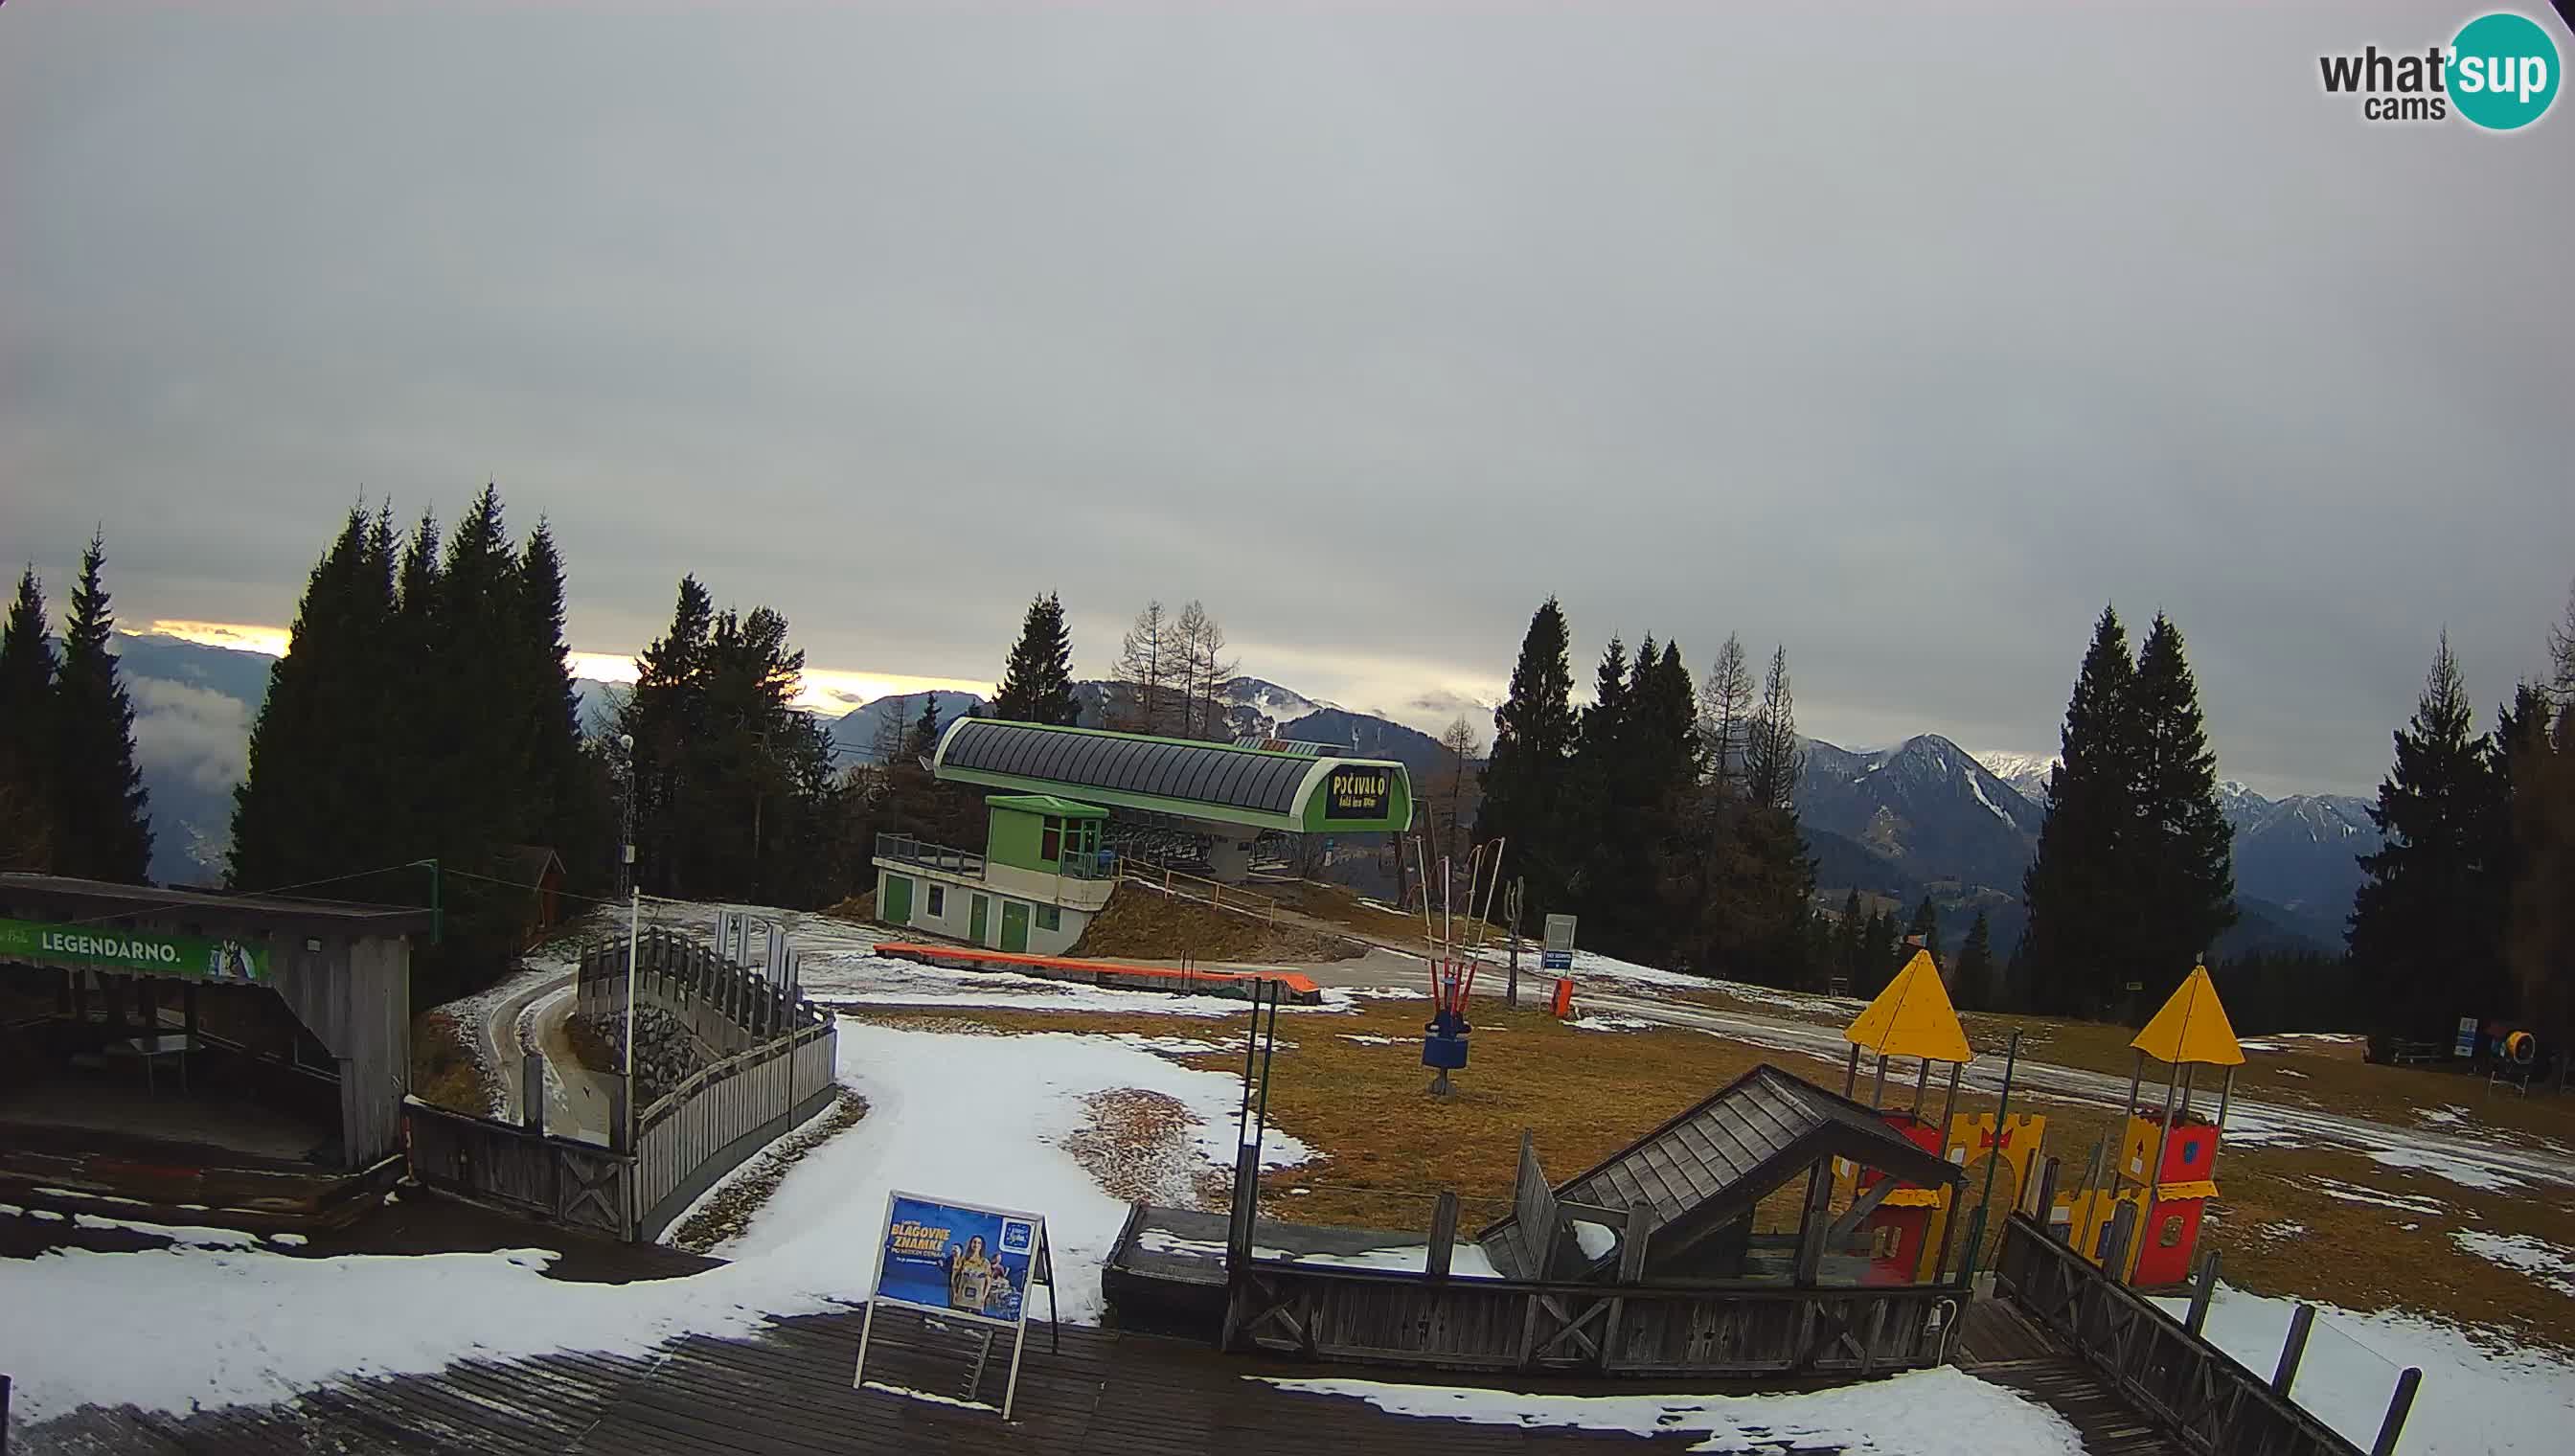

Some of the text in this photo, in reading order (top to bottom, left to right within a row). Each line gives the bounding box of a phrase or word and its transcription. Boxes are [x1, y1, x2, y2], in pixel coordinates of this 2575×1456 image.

[42, 931, 181, 963] LEGENDARNO.
[891, 1223, 951, 1241] BLAGOVNE
[894, 1236, 944, 1252] ZNAMKE
